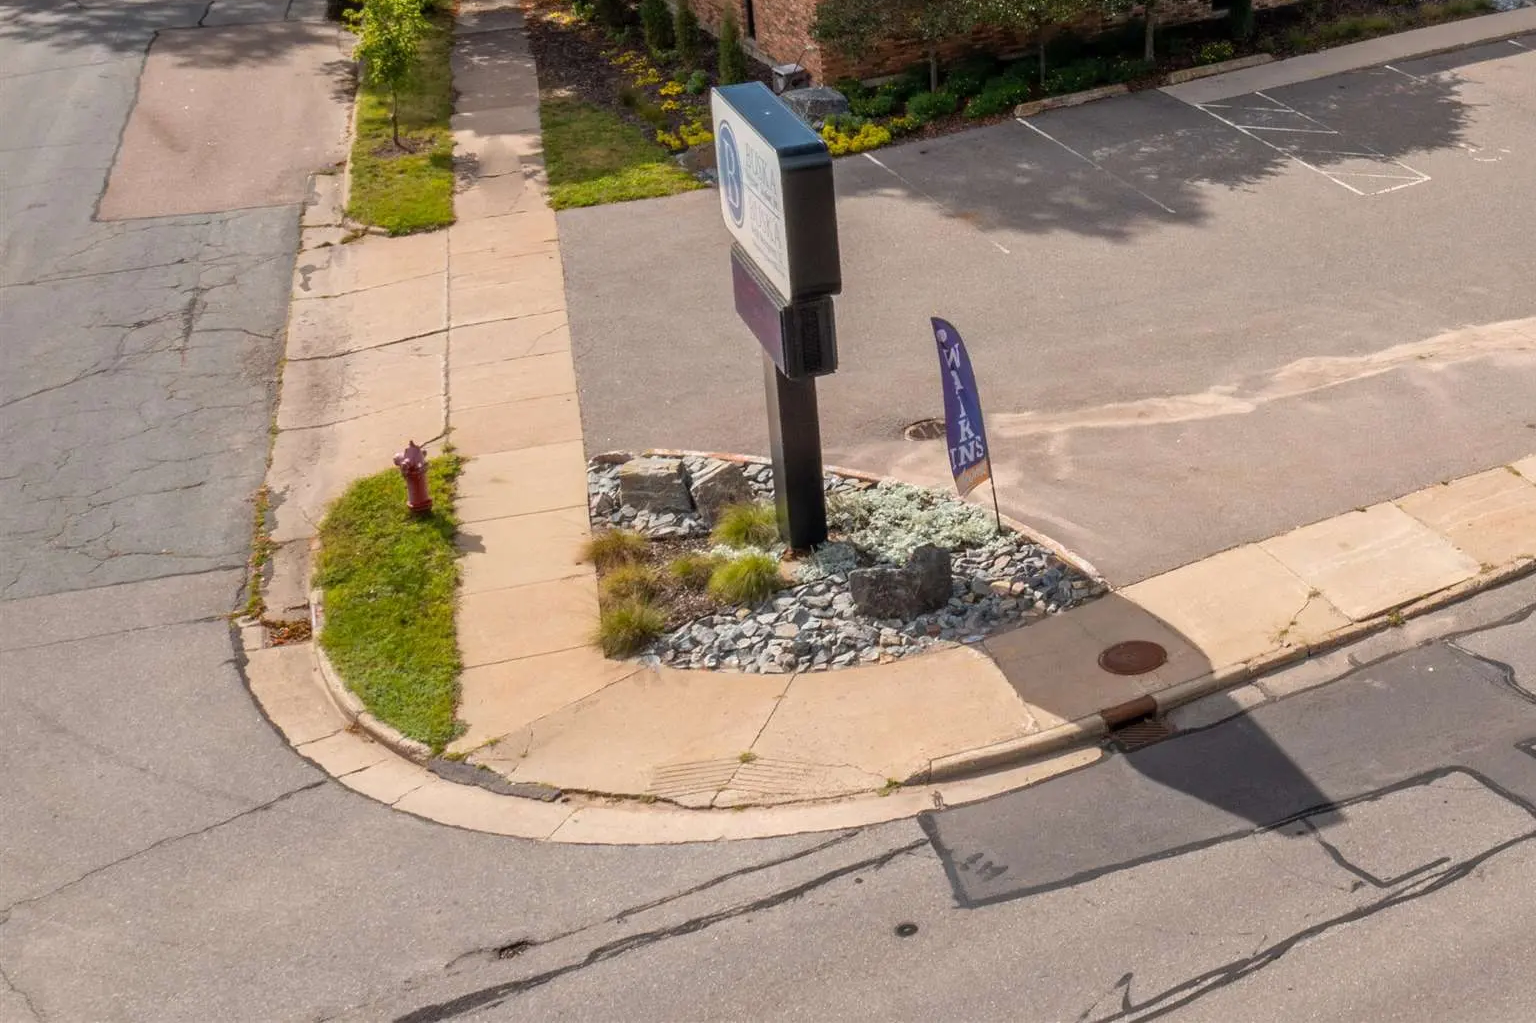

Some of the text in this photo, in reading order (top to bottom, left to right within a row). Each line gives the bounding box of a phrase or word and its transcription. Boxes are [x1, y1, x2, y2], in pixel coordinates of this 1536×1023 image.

[745, 142, 777, 195] BUSKA
[749, 198, 783, 249] BUSKA
[950, 436, 984, 470] INS
